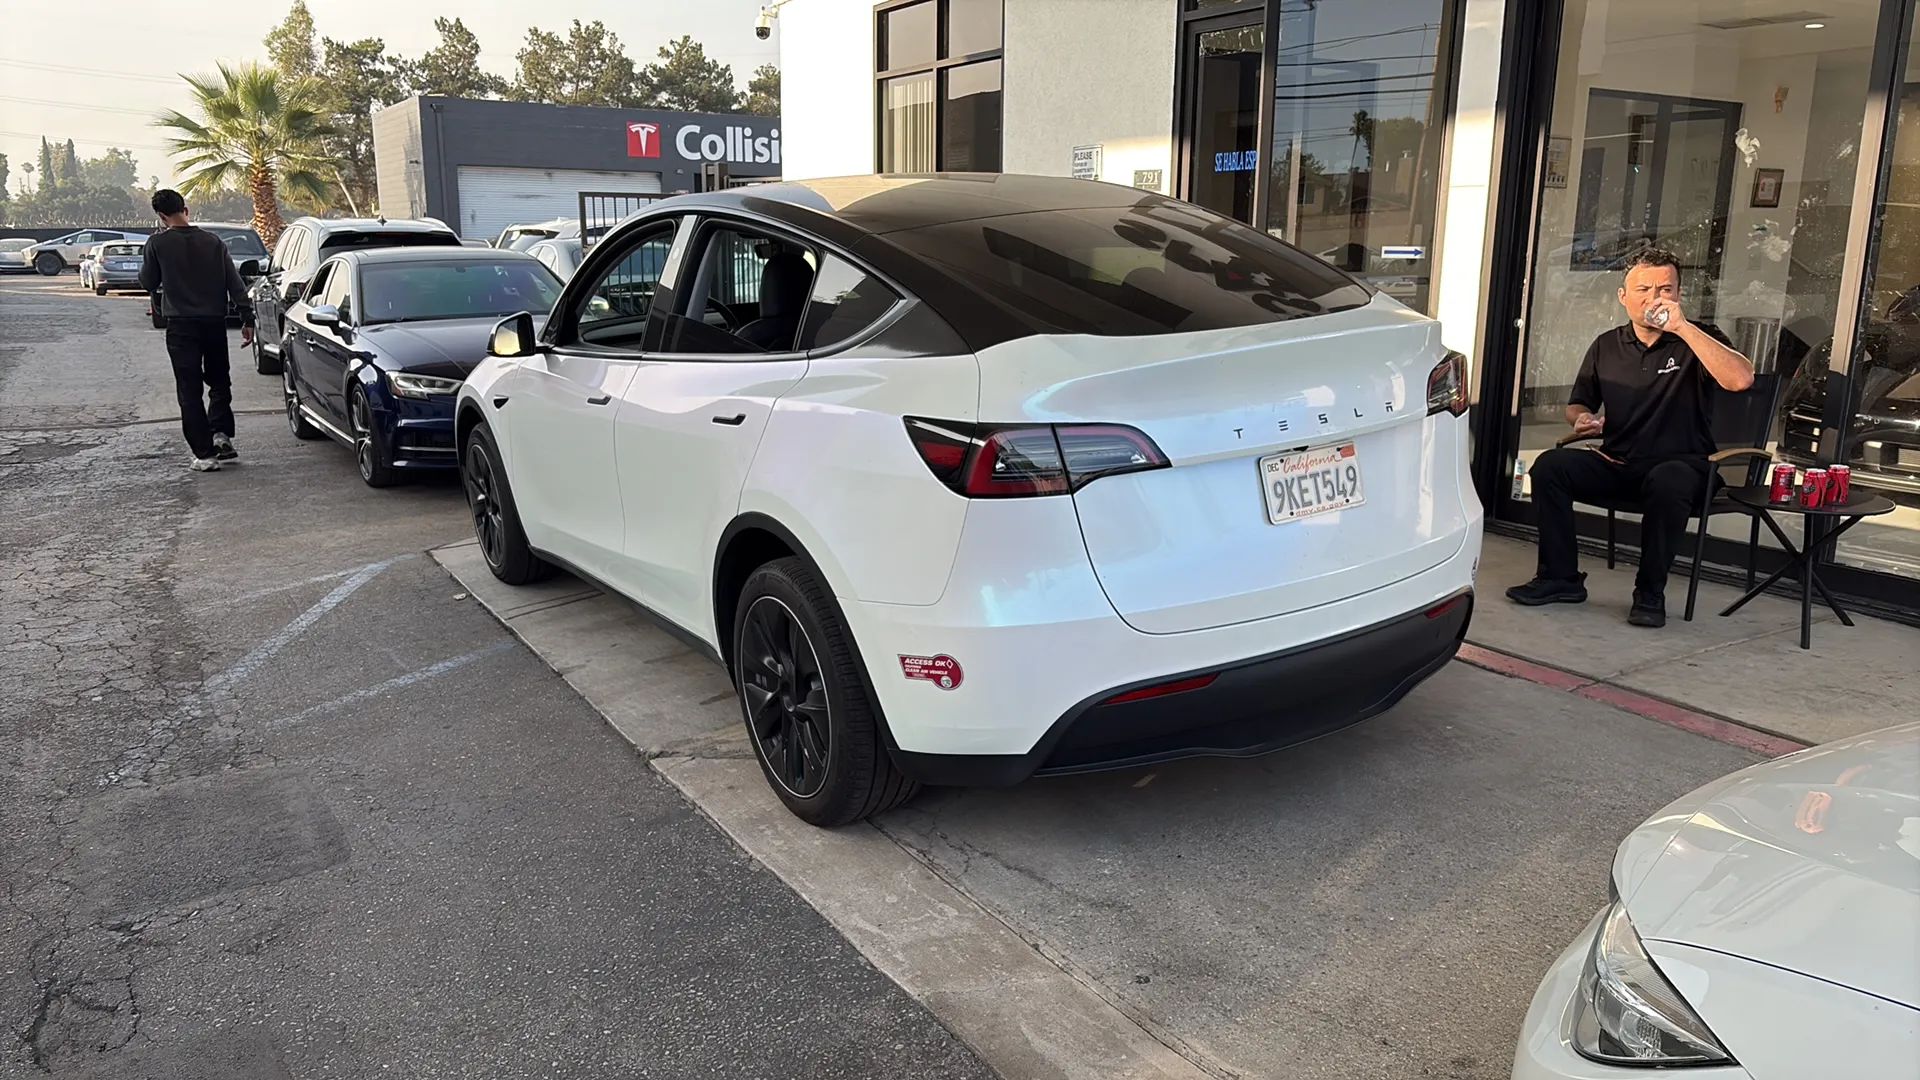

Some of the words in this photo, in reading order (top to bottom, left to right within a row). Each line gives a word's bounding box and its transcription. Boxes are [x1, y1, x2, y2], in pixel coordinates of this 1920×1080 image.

[675, 124, 780, 164] Collisi
[1075, 151, 1092, 160] PLEASE
[1223, 151, 1244, 171] HABLA
[1142, 171, 1158, 183] 791
[1267, 462, 1280, 473] DEC
[1283, 453, 1343, 474] California
[1273, 465, 1358, 514] 9KET549
